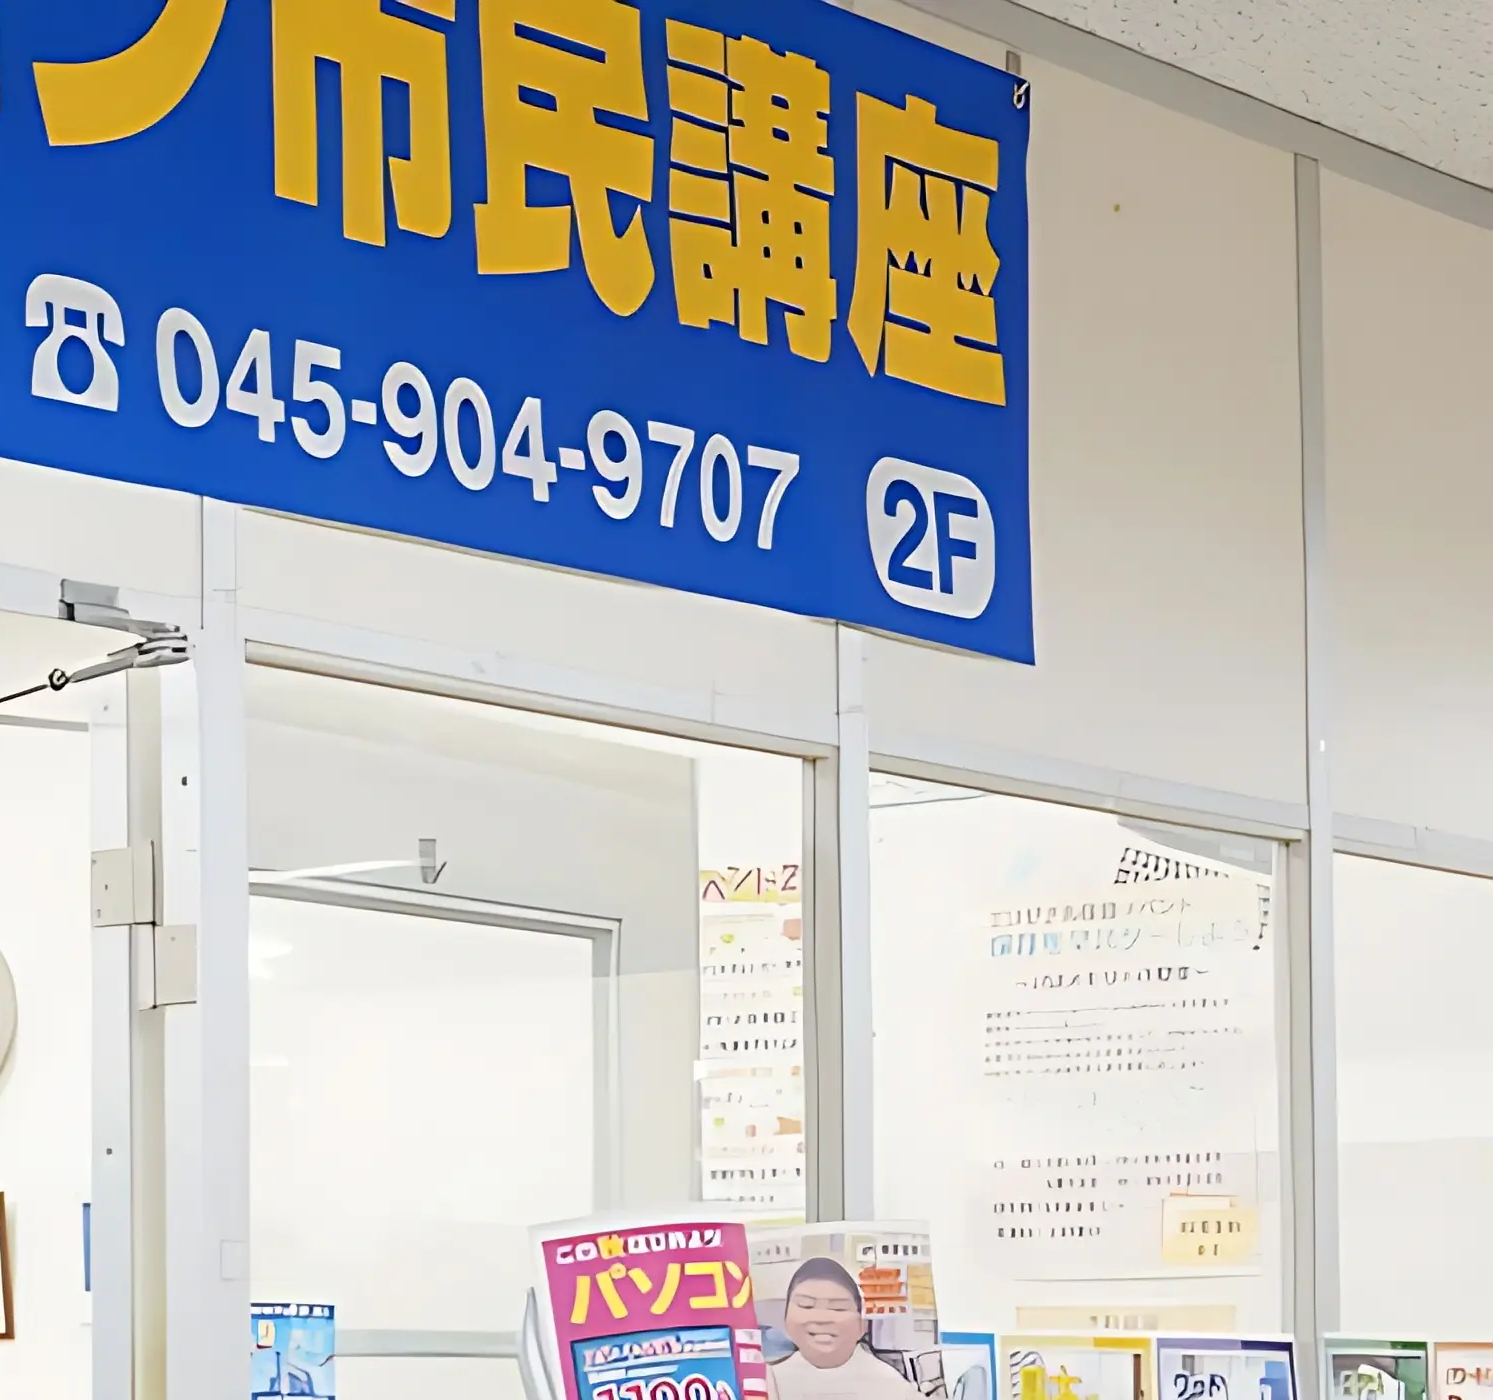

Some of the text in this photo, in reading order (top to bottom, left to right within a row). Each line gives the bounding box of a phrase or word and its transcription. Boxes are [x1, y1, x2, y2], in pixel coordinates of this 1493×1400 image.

[156, 307, 800, 551] 045-904-9707
[883, 480, 980, 595] 2F
[569, 1262, 753, 1325] パソコン
